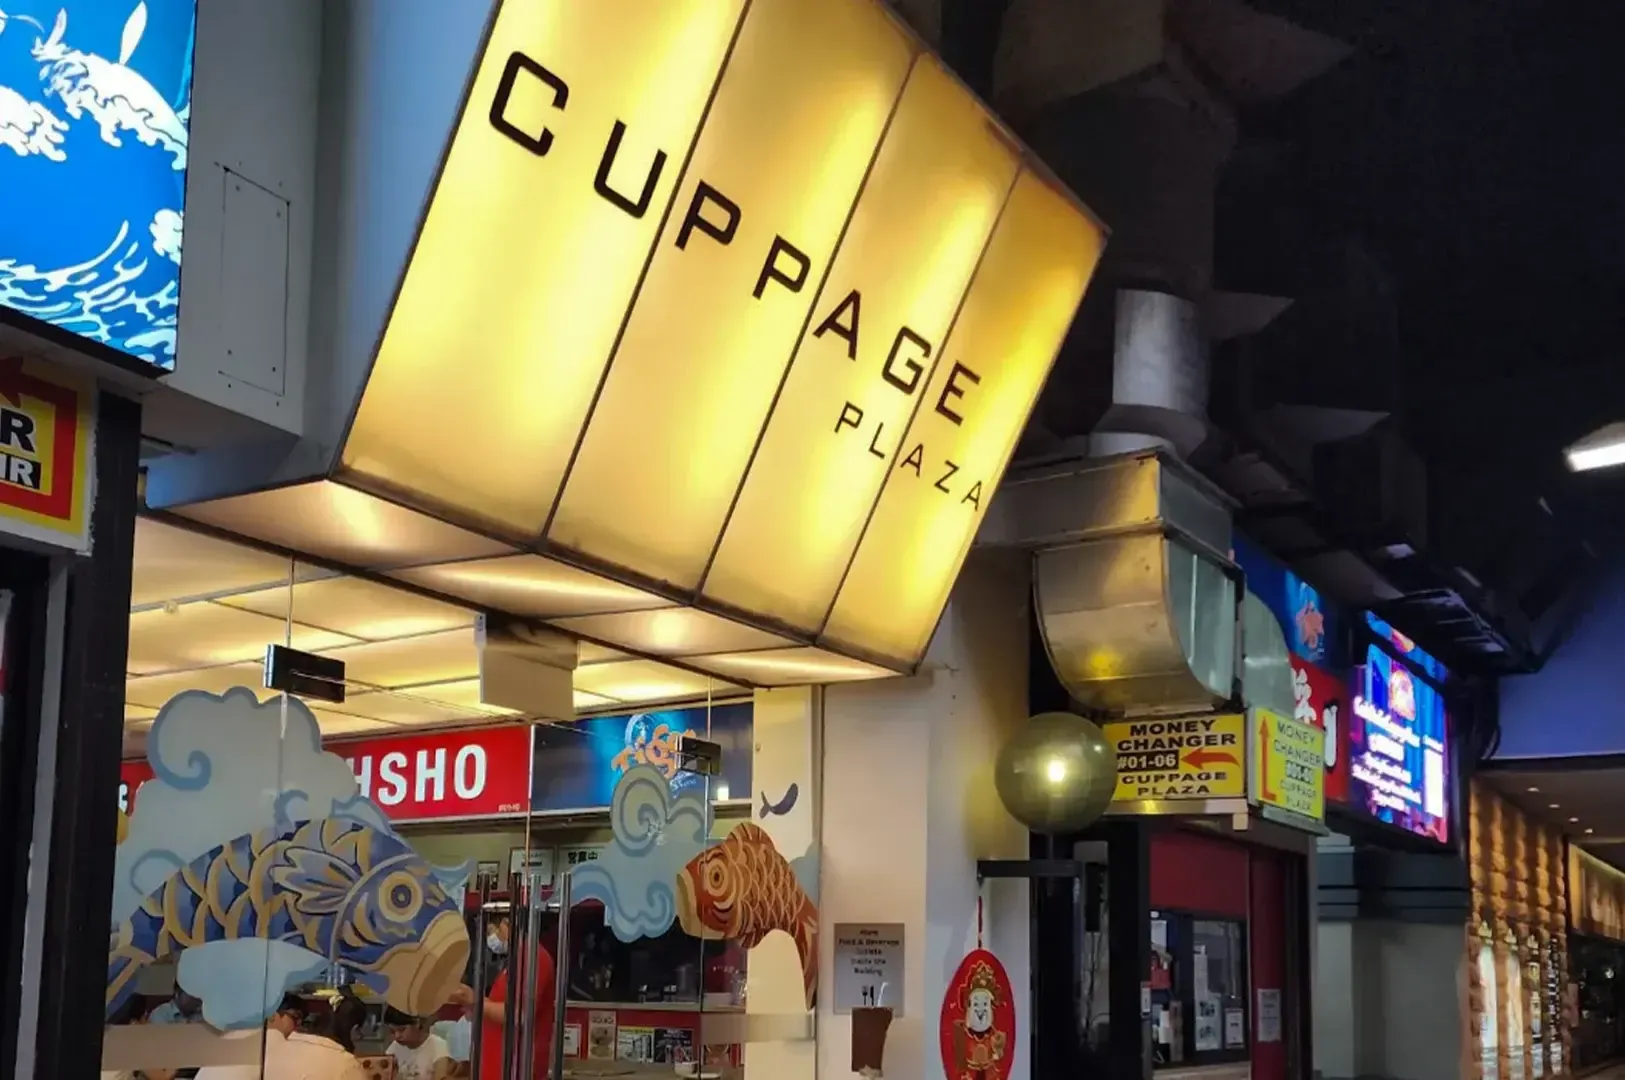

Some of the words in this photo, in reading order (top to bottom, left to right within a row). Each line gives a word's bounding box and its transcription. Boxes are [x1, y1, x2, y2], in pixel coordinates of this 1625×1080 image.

[489, 51, 981, 426] CUPPAGE
[834, 401, 983, 511] PLAZA
[1130, 719, 1217, 737] MONEY
[1276, 719, 1315, 745] MONEY
[1117, 733, 1237, 752] CHANGER
[1117, 753, 1177, 770] #01-06
[1273, 739, 1322, 766] CHANGER
[1122, 771, 1228, 785] CUPPAGE
[1137, 784, 1211, 797] PLAZA
